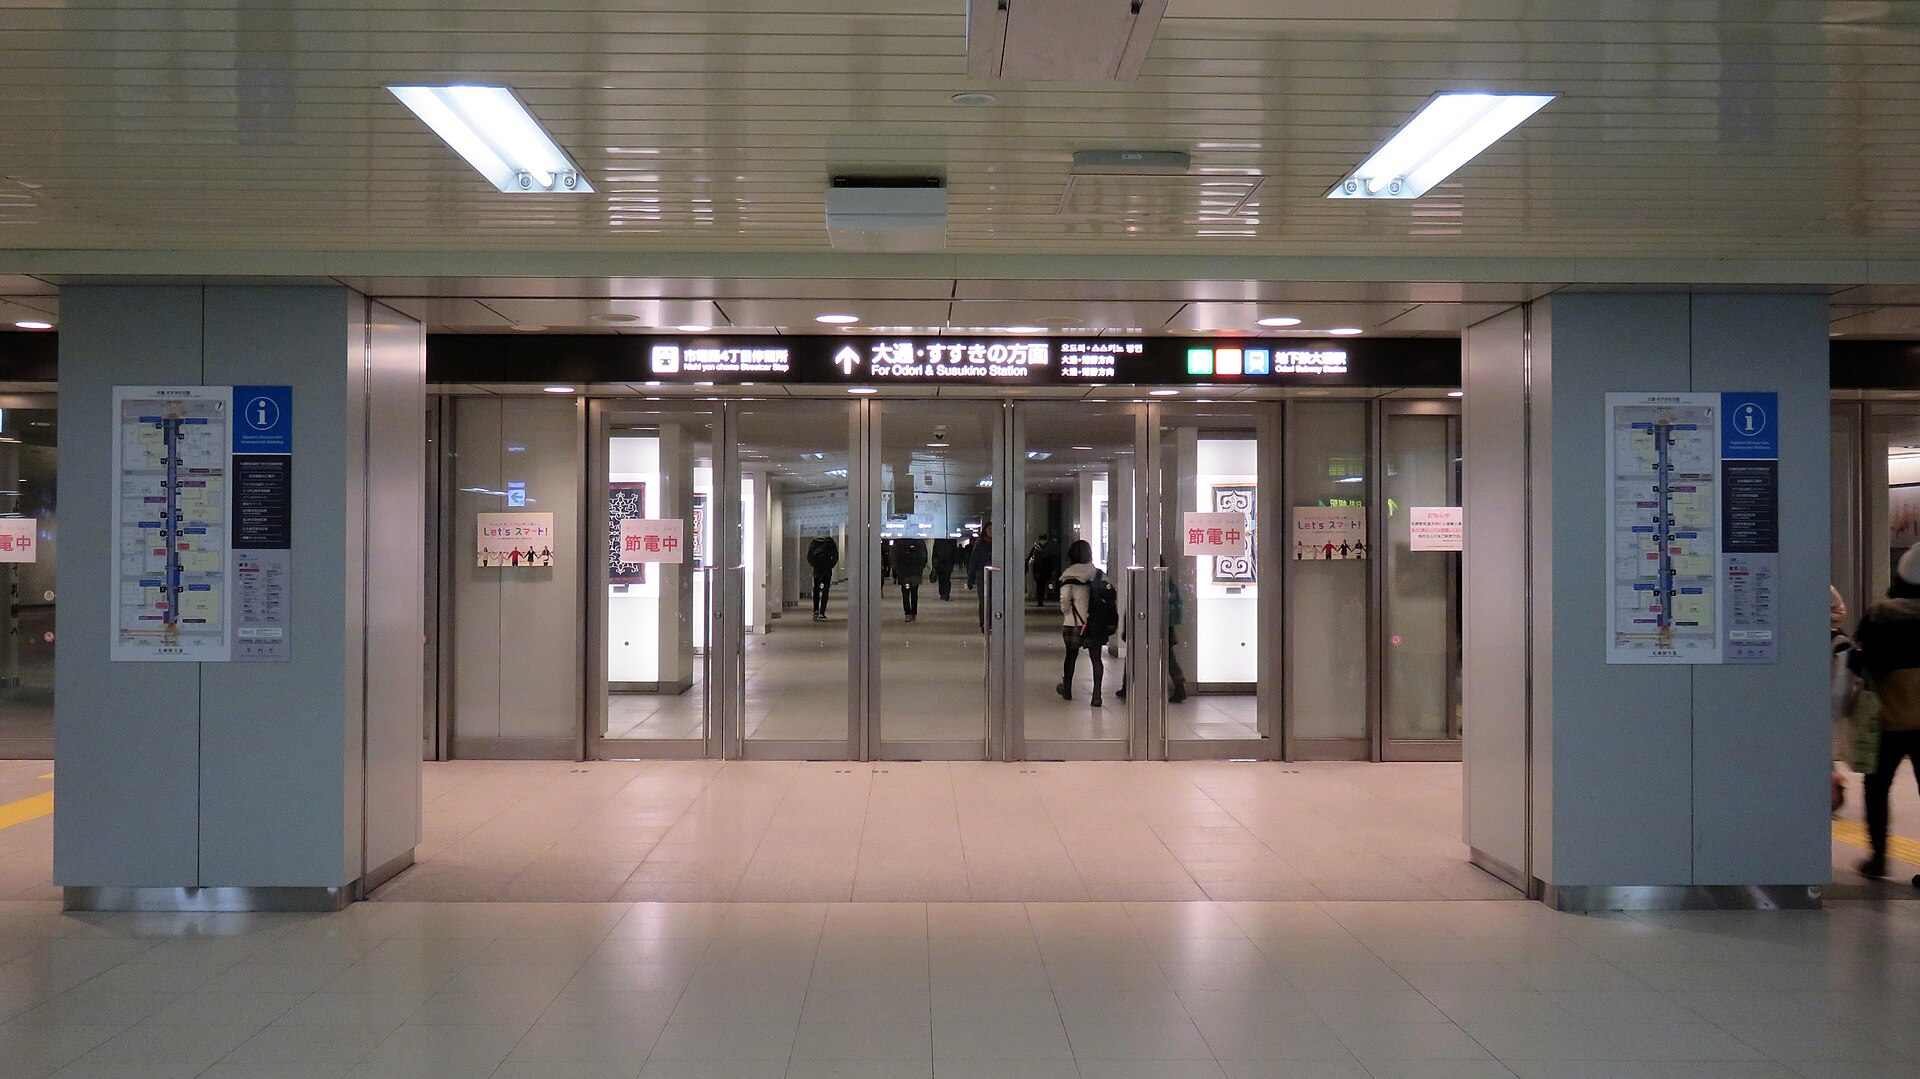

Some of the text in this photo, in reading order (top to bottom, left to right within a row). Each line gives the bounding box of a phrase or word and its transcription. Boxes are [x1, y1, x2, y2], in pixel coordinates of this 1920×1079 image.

[871, 343, 1049, 365] 大通・すすきの方面
[871, 365, 1028, 376] For Odori & Susukino Station
[483, 527, 511, 537] Let's
[1297, 520, 1325, 530] Let's
[1188, 528, 1241, 545] 節電中
[625, 535, 678, 553] 節電中
